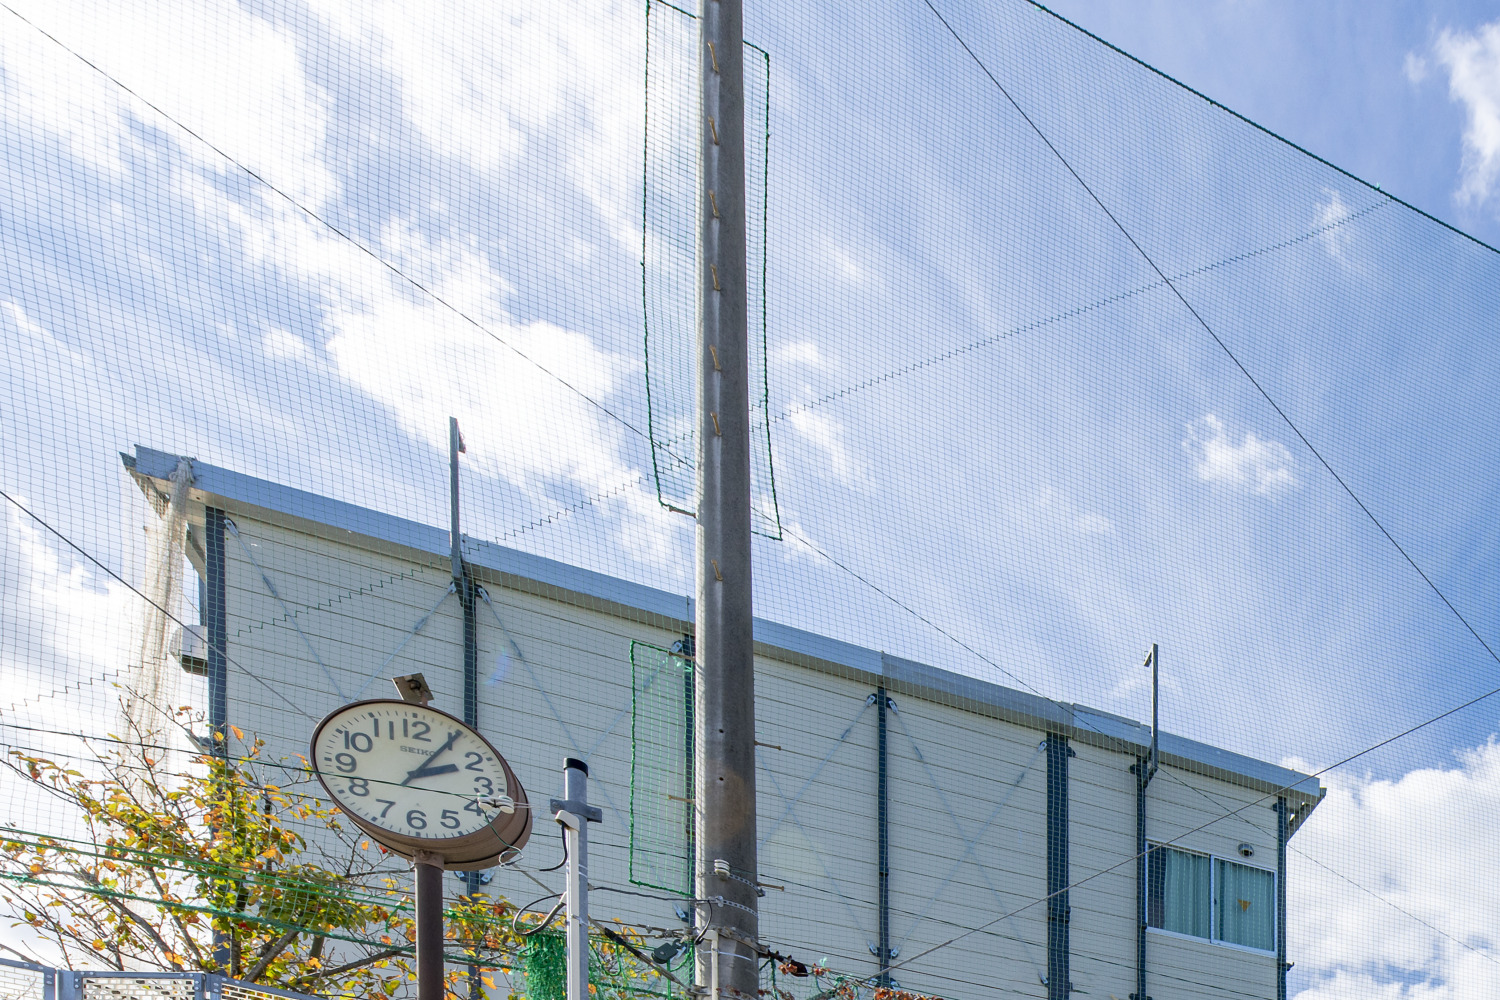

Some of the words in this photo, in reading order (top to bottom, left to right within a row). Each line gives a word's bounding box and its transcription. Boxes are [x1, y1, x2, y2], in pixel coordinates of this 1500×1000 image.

[374, 717, 395, 741] 11
[402, 718, 432, 743] 12
[343, 729, 374, 753] 10
[400, 745, 436, 757] SEIKO
[335, 752, 358, 774] 9
[464, 751, 484, 773] 2
[348, 776, 370, 797] 8
[473, 776, 494, 797] 3
[375, 798, 397, 819] 7
[463, 798, 484, 818] 4
[406, 809, 428, 830] 6
[439, 809, 461, 830] 5
